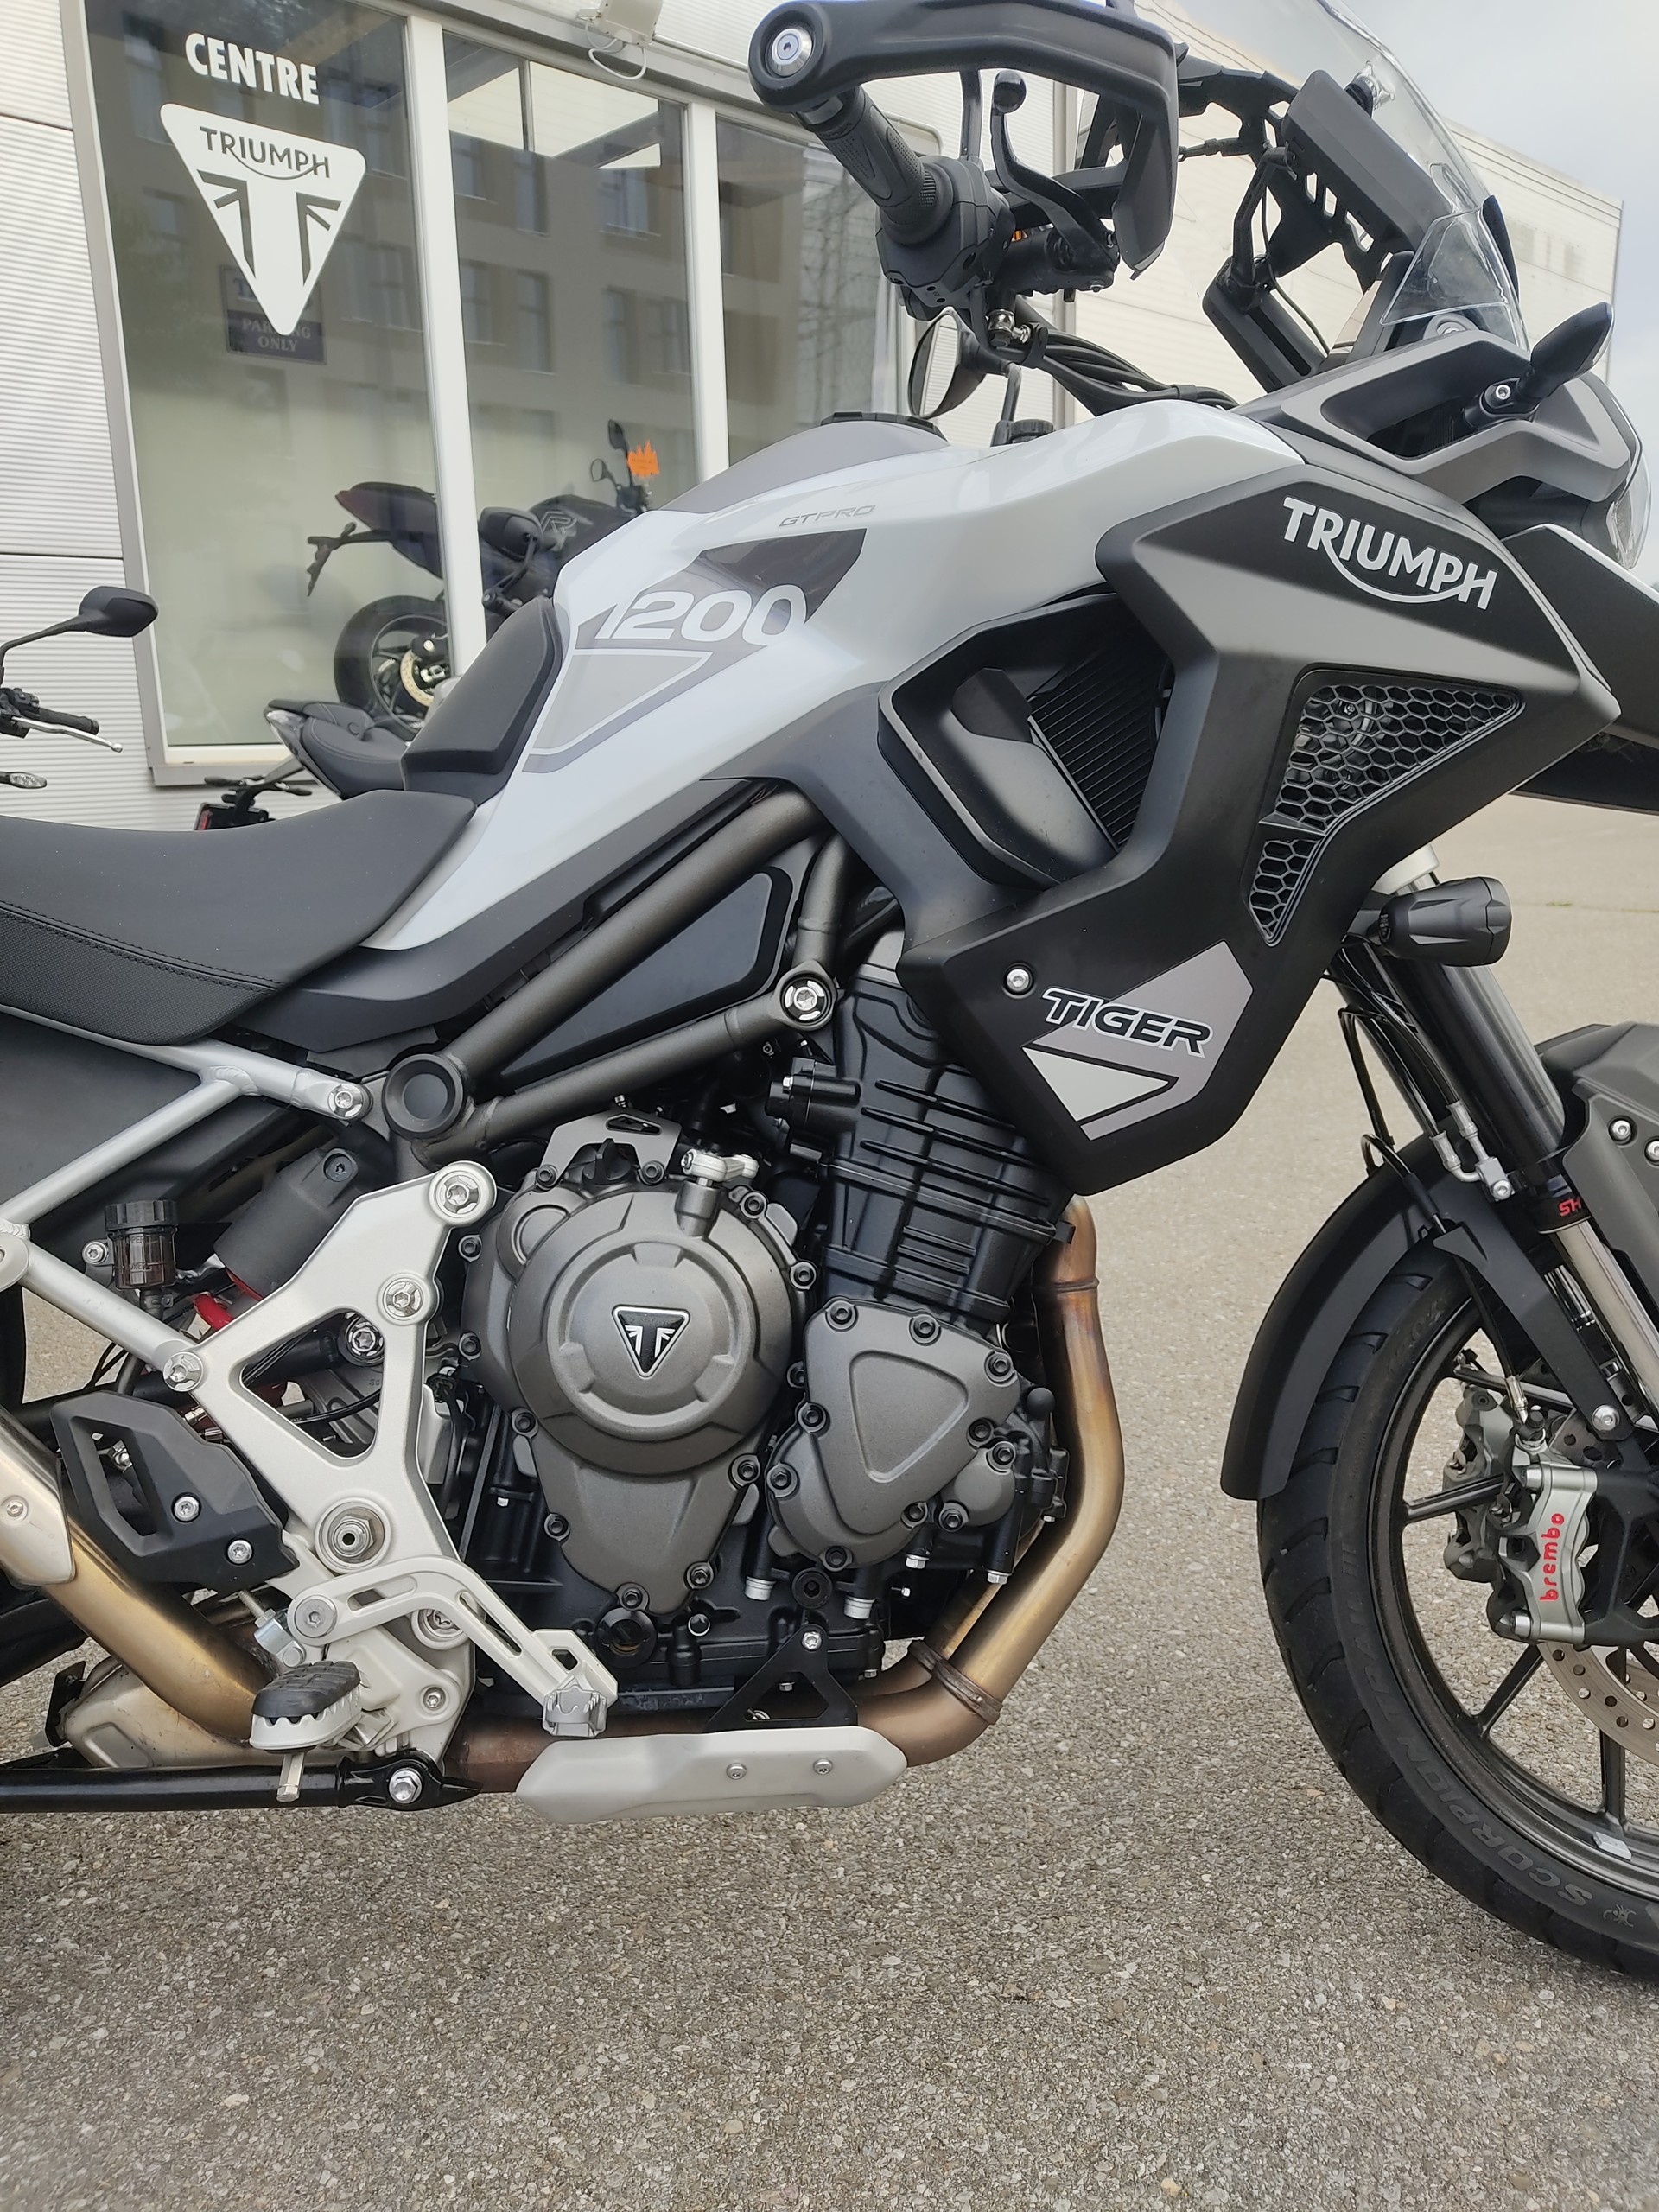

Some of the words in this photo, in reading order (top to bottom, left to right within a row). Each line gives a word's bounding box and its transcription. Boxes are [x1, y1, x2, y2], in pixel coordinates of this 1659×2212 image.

[185, 32, 320, 105] CENTRE
[199, 125, 330, 181] TRIUMPH
[242, 317, 311, 339] PARNG
[257, 335, 298, 352] ONLY
[1282, 496, 1498, 610] TRIUMPH
[594, 583, 807, 647] 1200
[1042, 988, 1214, 1058] TIGER
[1539, 1513, 1565, 1602] brembo
[1396, 1736, 1593, 1907] SCORPION
